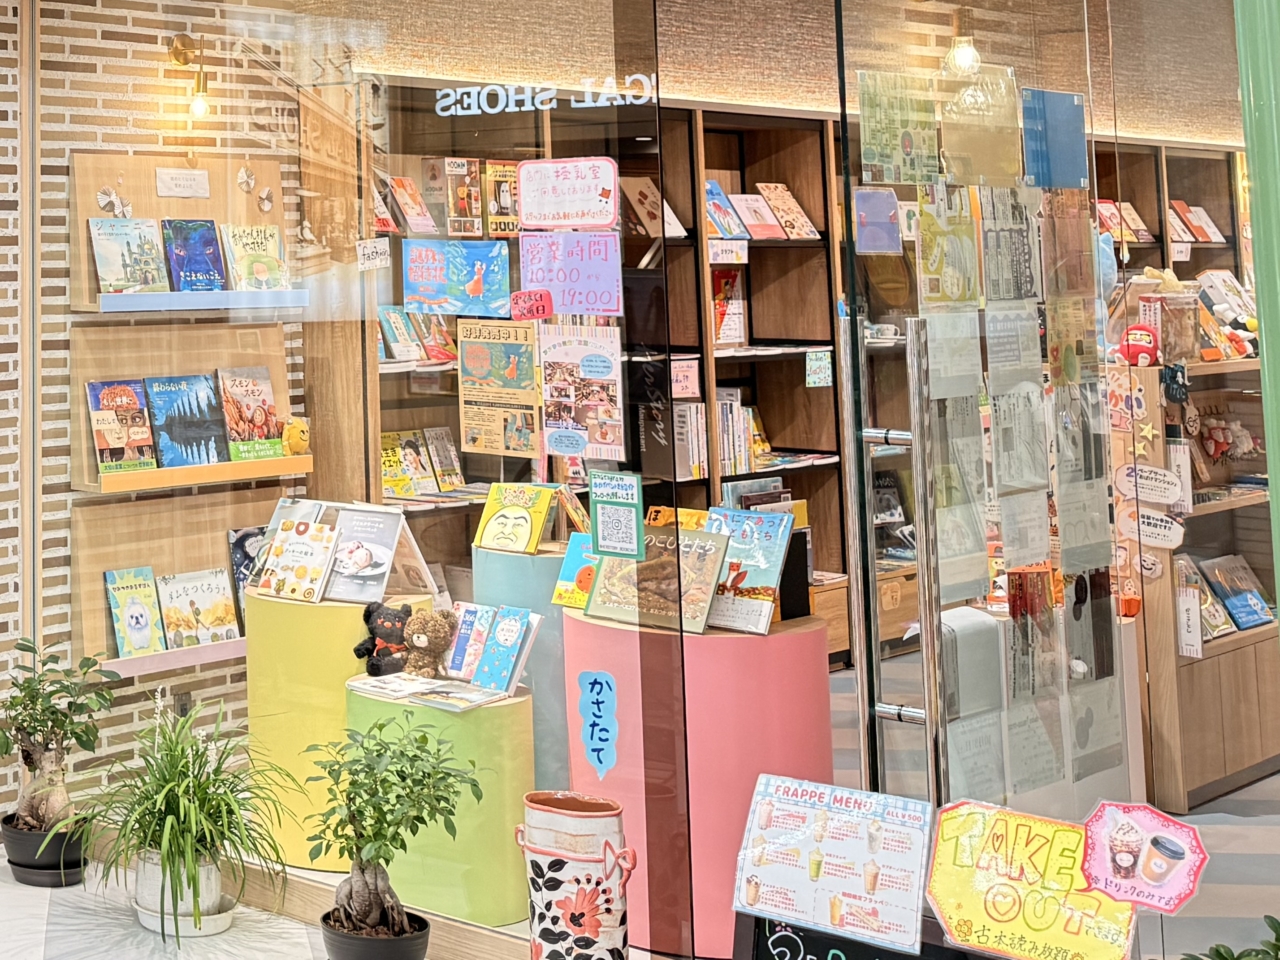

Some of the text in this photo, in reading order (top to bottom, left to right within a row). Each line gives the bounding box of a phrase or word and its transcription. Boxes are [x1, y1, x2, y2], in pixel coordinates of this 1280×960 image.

[95, 220, 154, 232] ジャーニー
[526, 239, 609, 265] 営業時間
[179, 269, 221, 281] きこえないこえ
[528, 268, 581, 284] 10:00
[512, 293, 544, 306] 定休日
[559, 288, 612, 307] 19:00
[152, 381, 188, 393] 終わらない夜
[230, 378, 251, 389] スモン
[243, 388, 264, 398] スモン
[588, 677, 613, 766] かさたて
[774, 784, 826, 804] FRAPPE
[885, 810, 922, 824] ALL ¥500
[941, 811, 1083, 893] TAKE
[983, 883, 1102, 936] OUT
